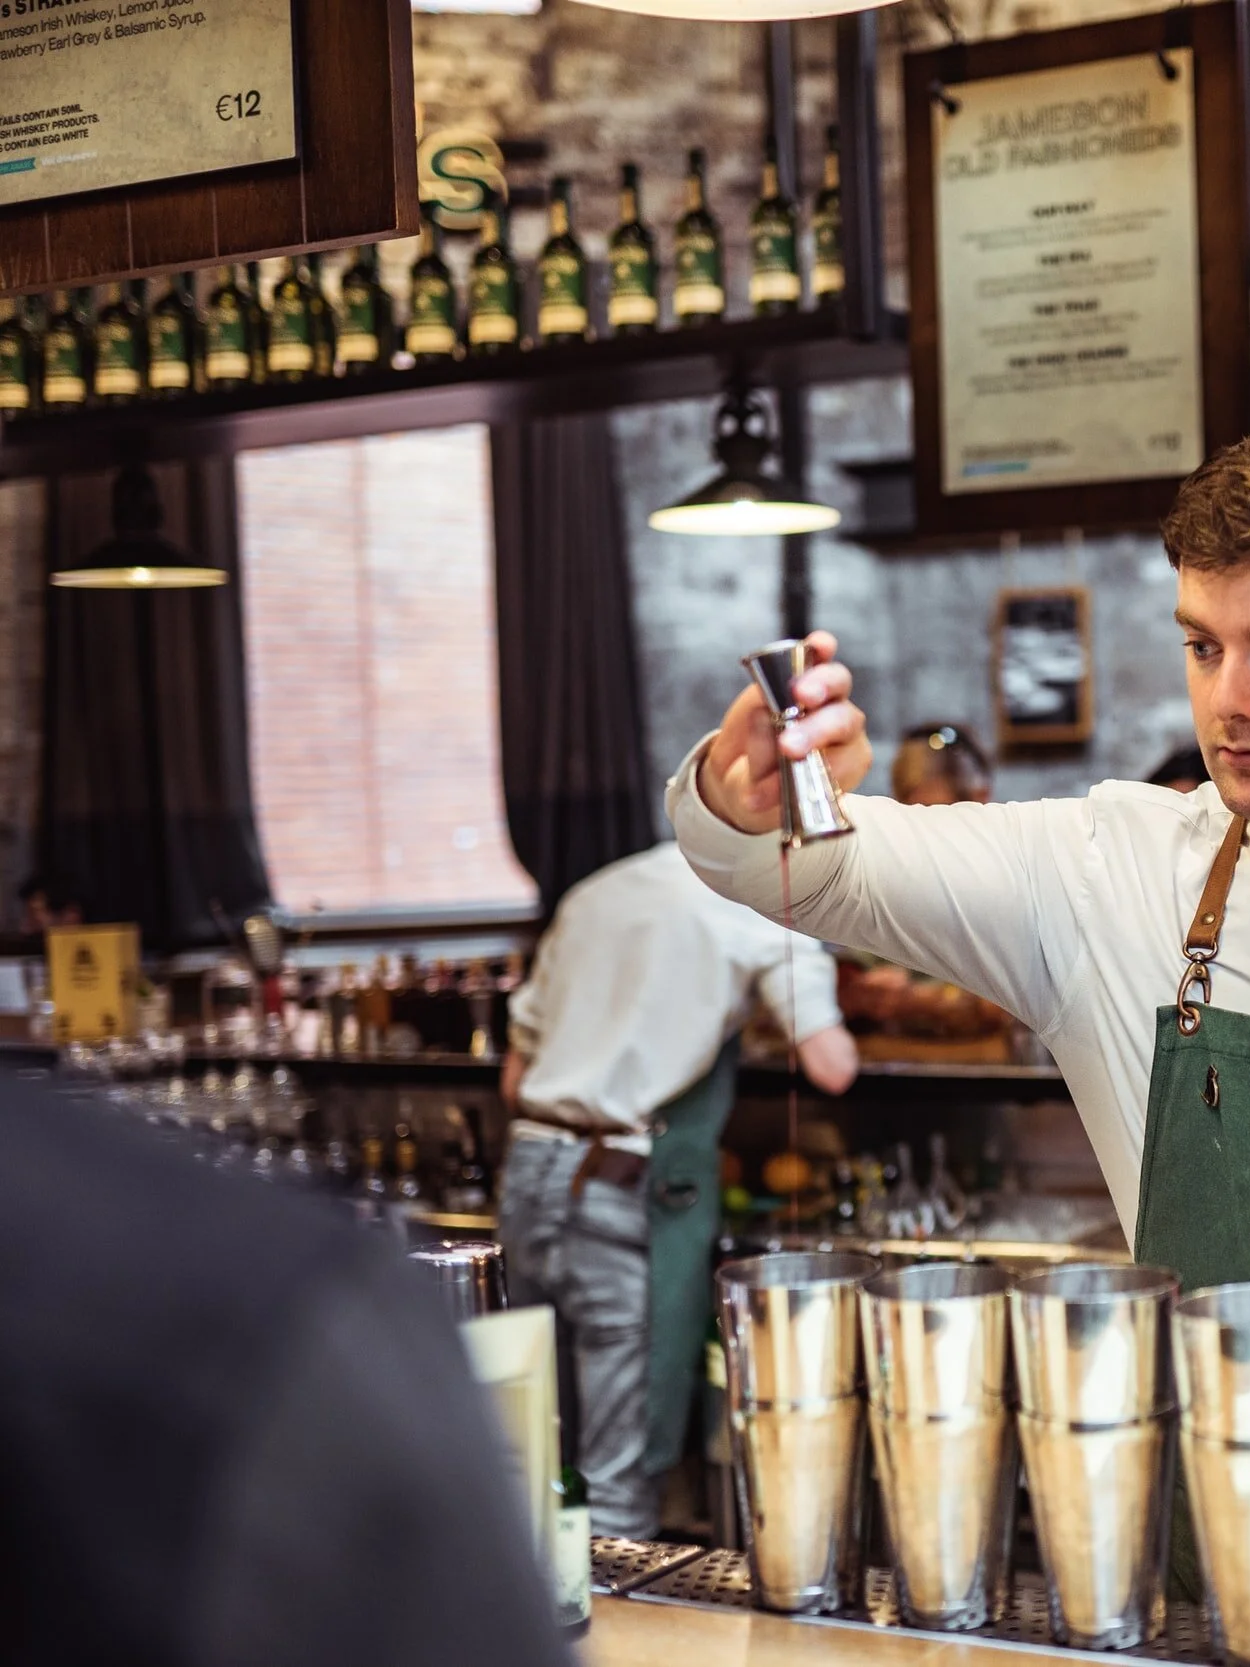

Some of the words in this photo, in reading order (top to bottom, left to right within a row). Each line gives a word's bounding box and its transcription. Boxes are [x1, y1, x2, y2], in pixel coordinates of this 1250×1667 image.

[41, 16, 63, 32] Irish
[65, 9, 116, 27] Whiskey,
[118, 0, 159, 17] Lemon
[48, 35, 71, 51] Earl
[72, 32, 101, 46] Grey
[103, 26, 113, 40] &
[115, 17, 166, 38] Balsamic
[168, 11, 206, 30] Syrup.
[22, 107, 60, 122] CONTAIN
[215, 89, 262, 122] €12
[13, 122, 50, 137] WHISKEY
[51, 113, 100, 131] PRODUCTS.
[4, 137, 41, 151] CONTAIN
[42, 132, 61, 145] EGG
[62, 128, 89, 142] WHITE
